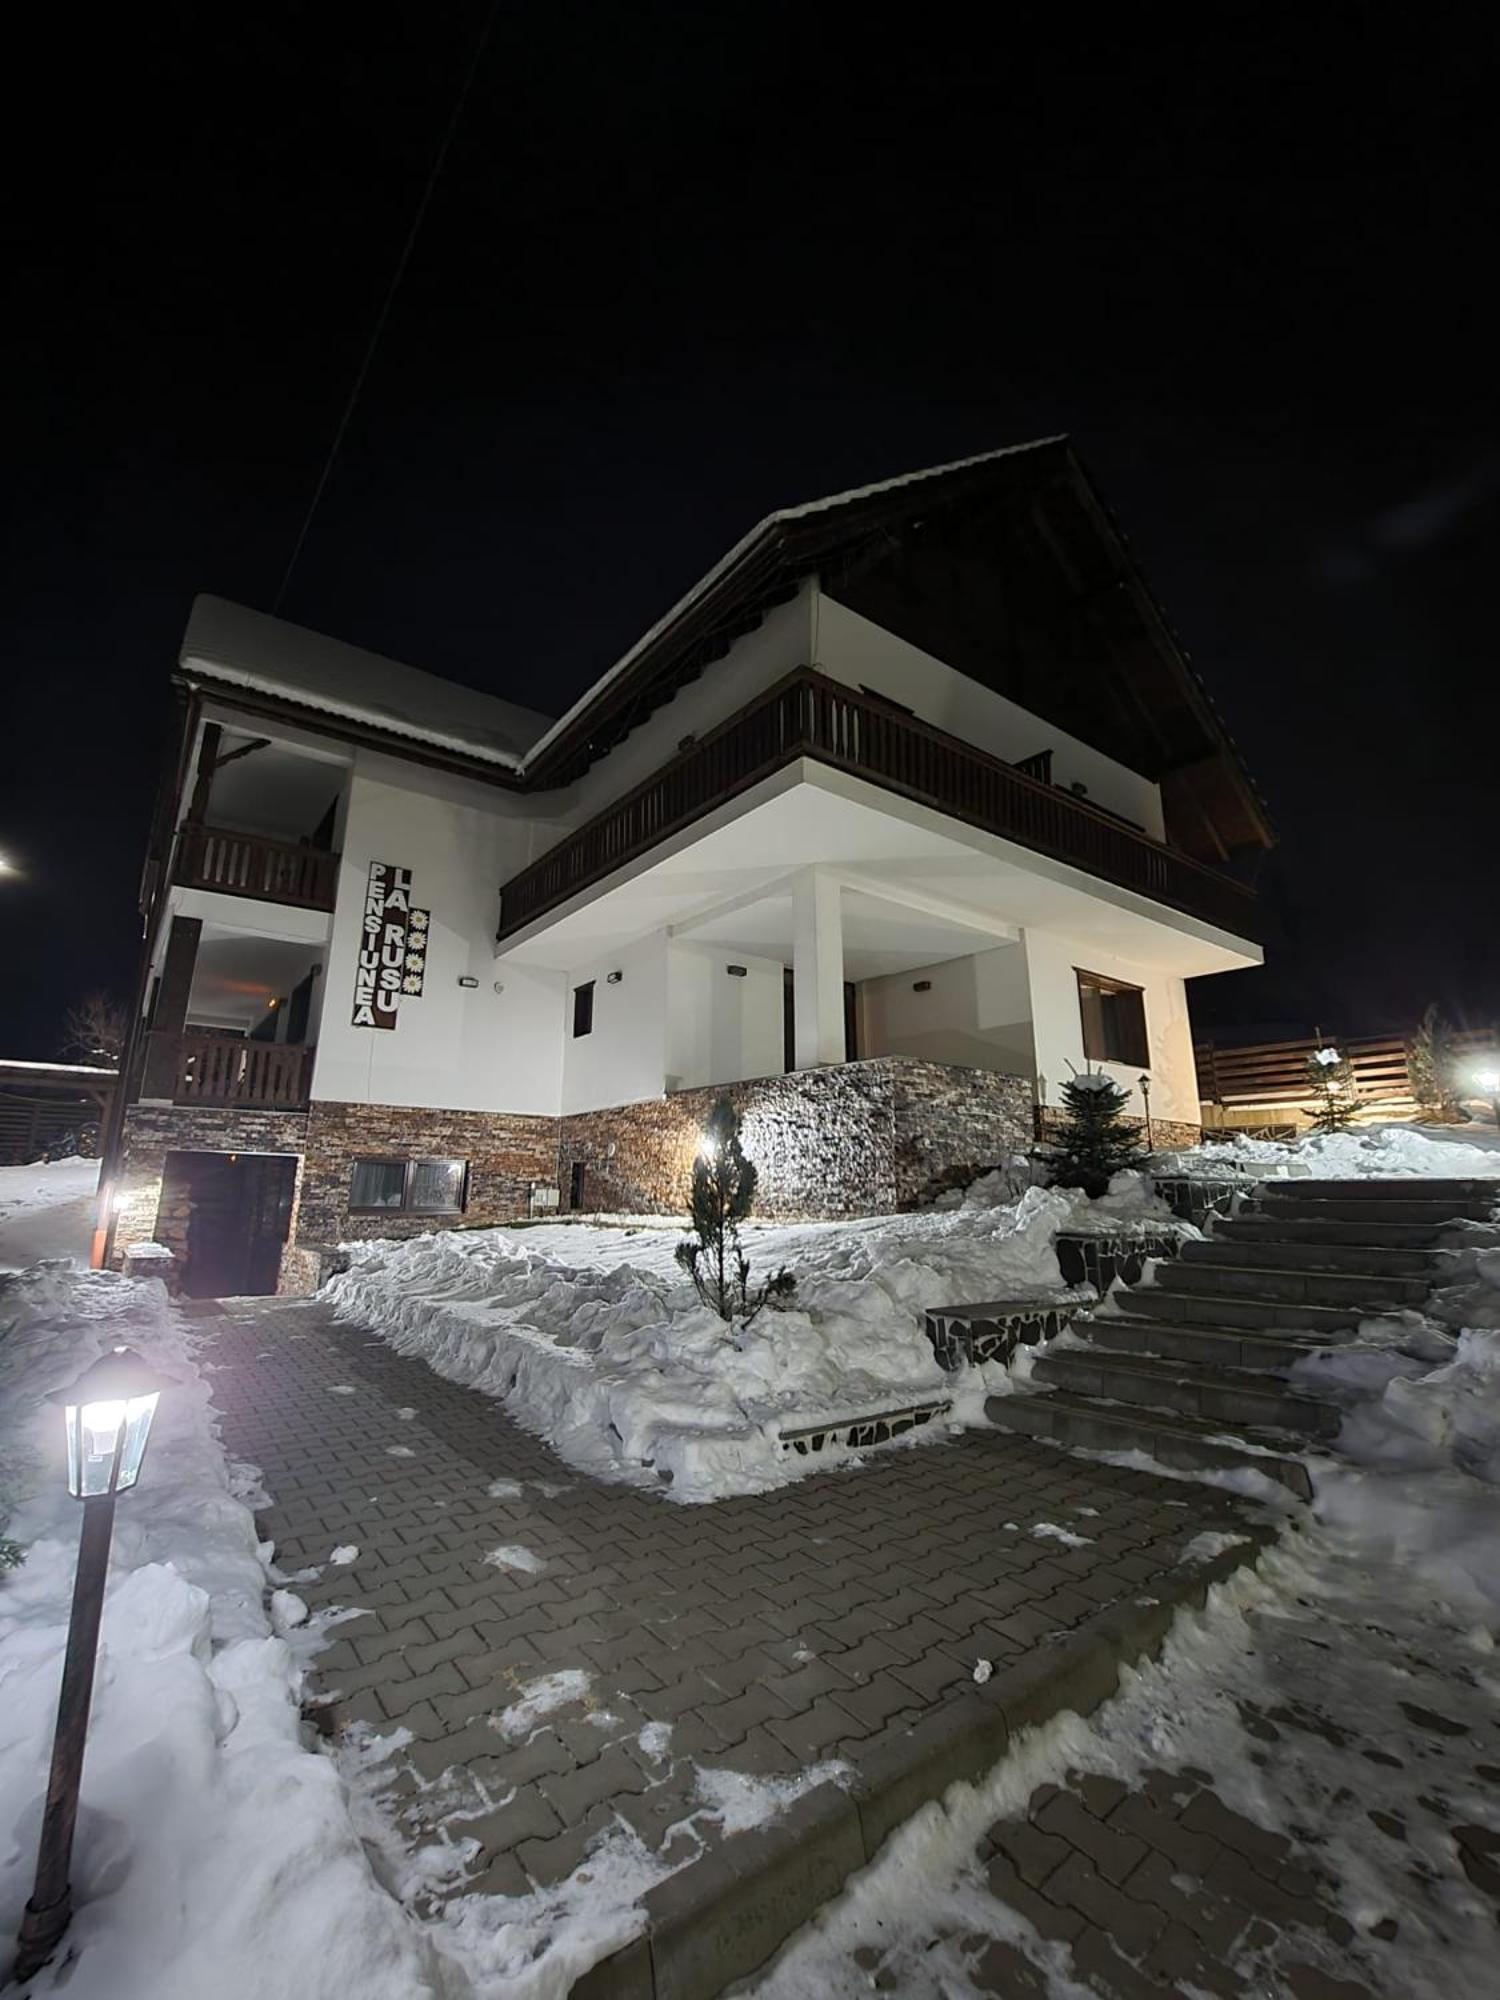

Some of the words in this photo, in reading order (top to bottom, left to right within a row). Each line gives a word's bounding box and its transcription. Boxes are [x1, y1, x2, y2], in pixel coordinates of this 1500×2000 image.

[384, 868, 410, 912] LA
[354, 863, 386, 1025] PENSIUNEA
[376, 923, 405, 1012] RUSU
